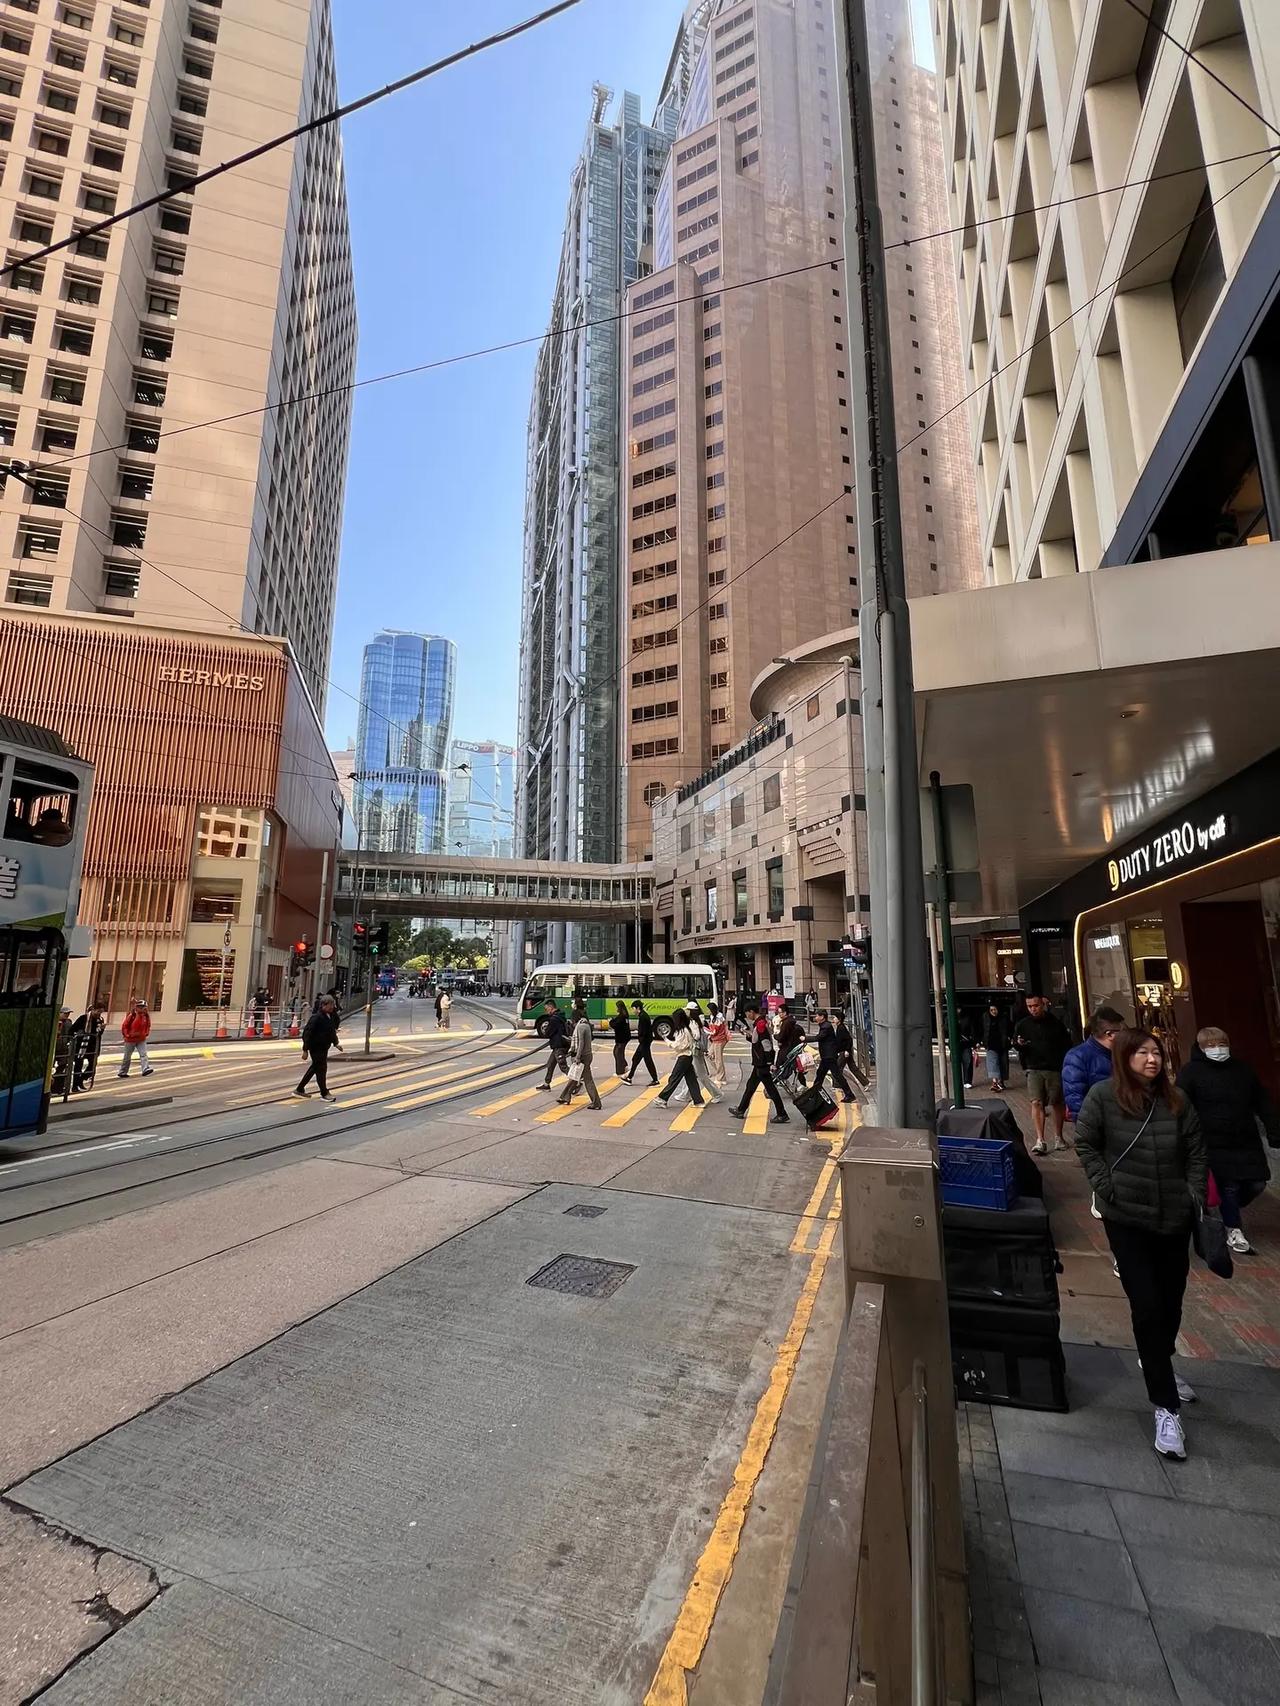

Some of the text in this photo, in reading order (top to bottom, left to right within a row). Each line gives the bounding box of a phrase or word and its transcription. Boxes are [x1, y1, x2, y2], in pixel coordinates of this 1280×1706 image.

[1119, 814, 1226, 883] DUTY ZERO by cdf
